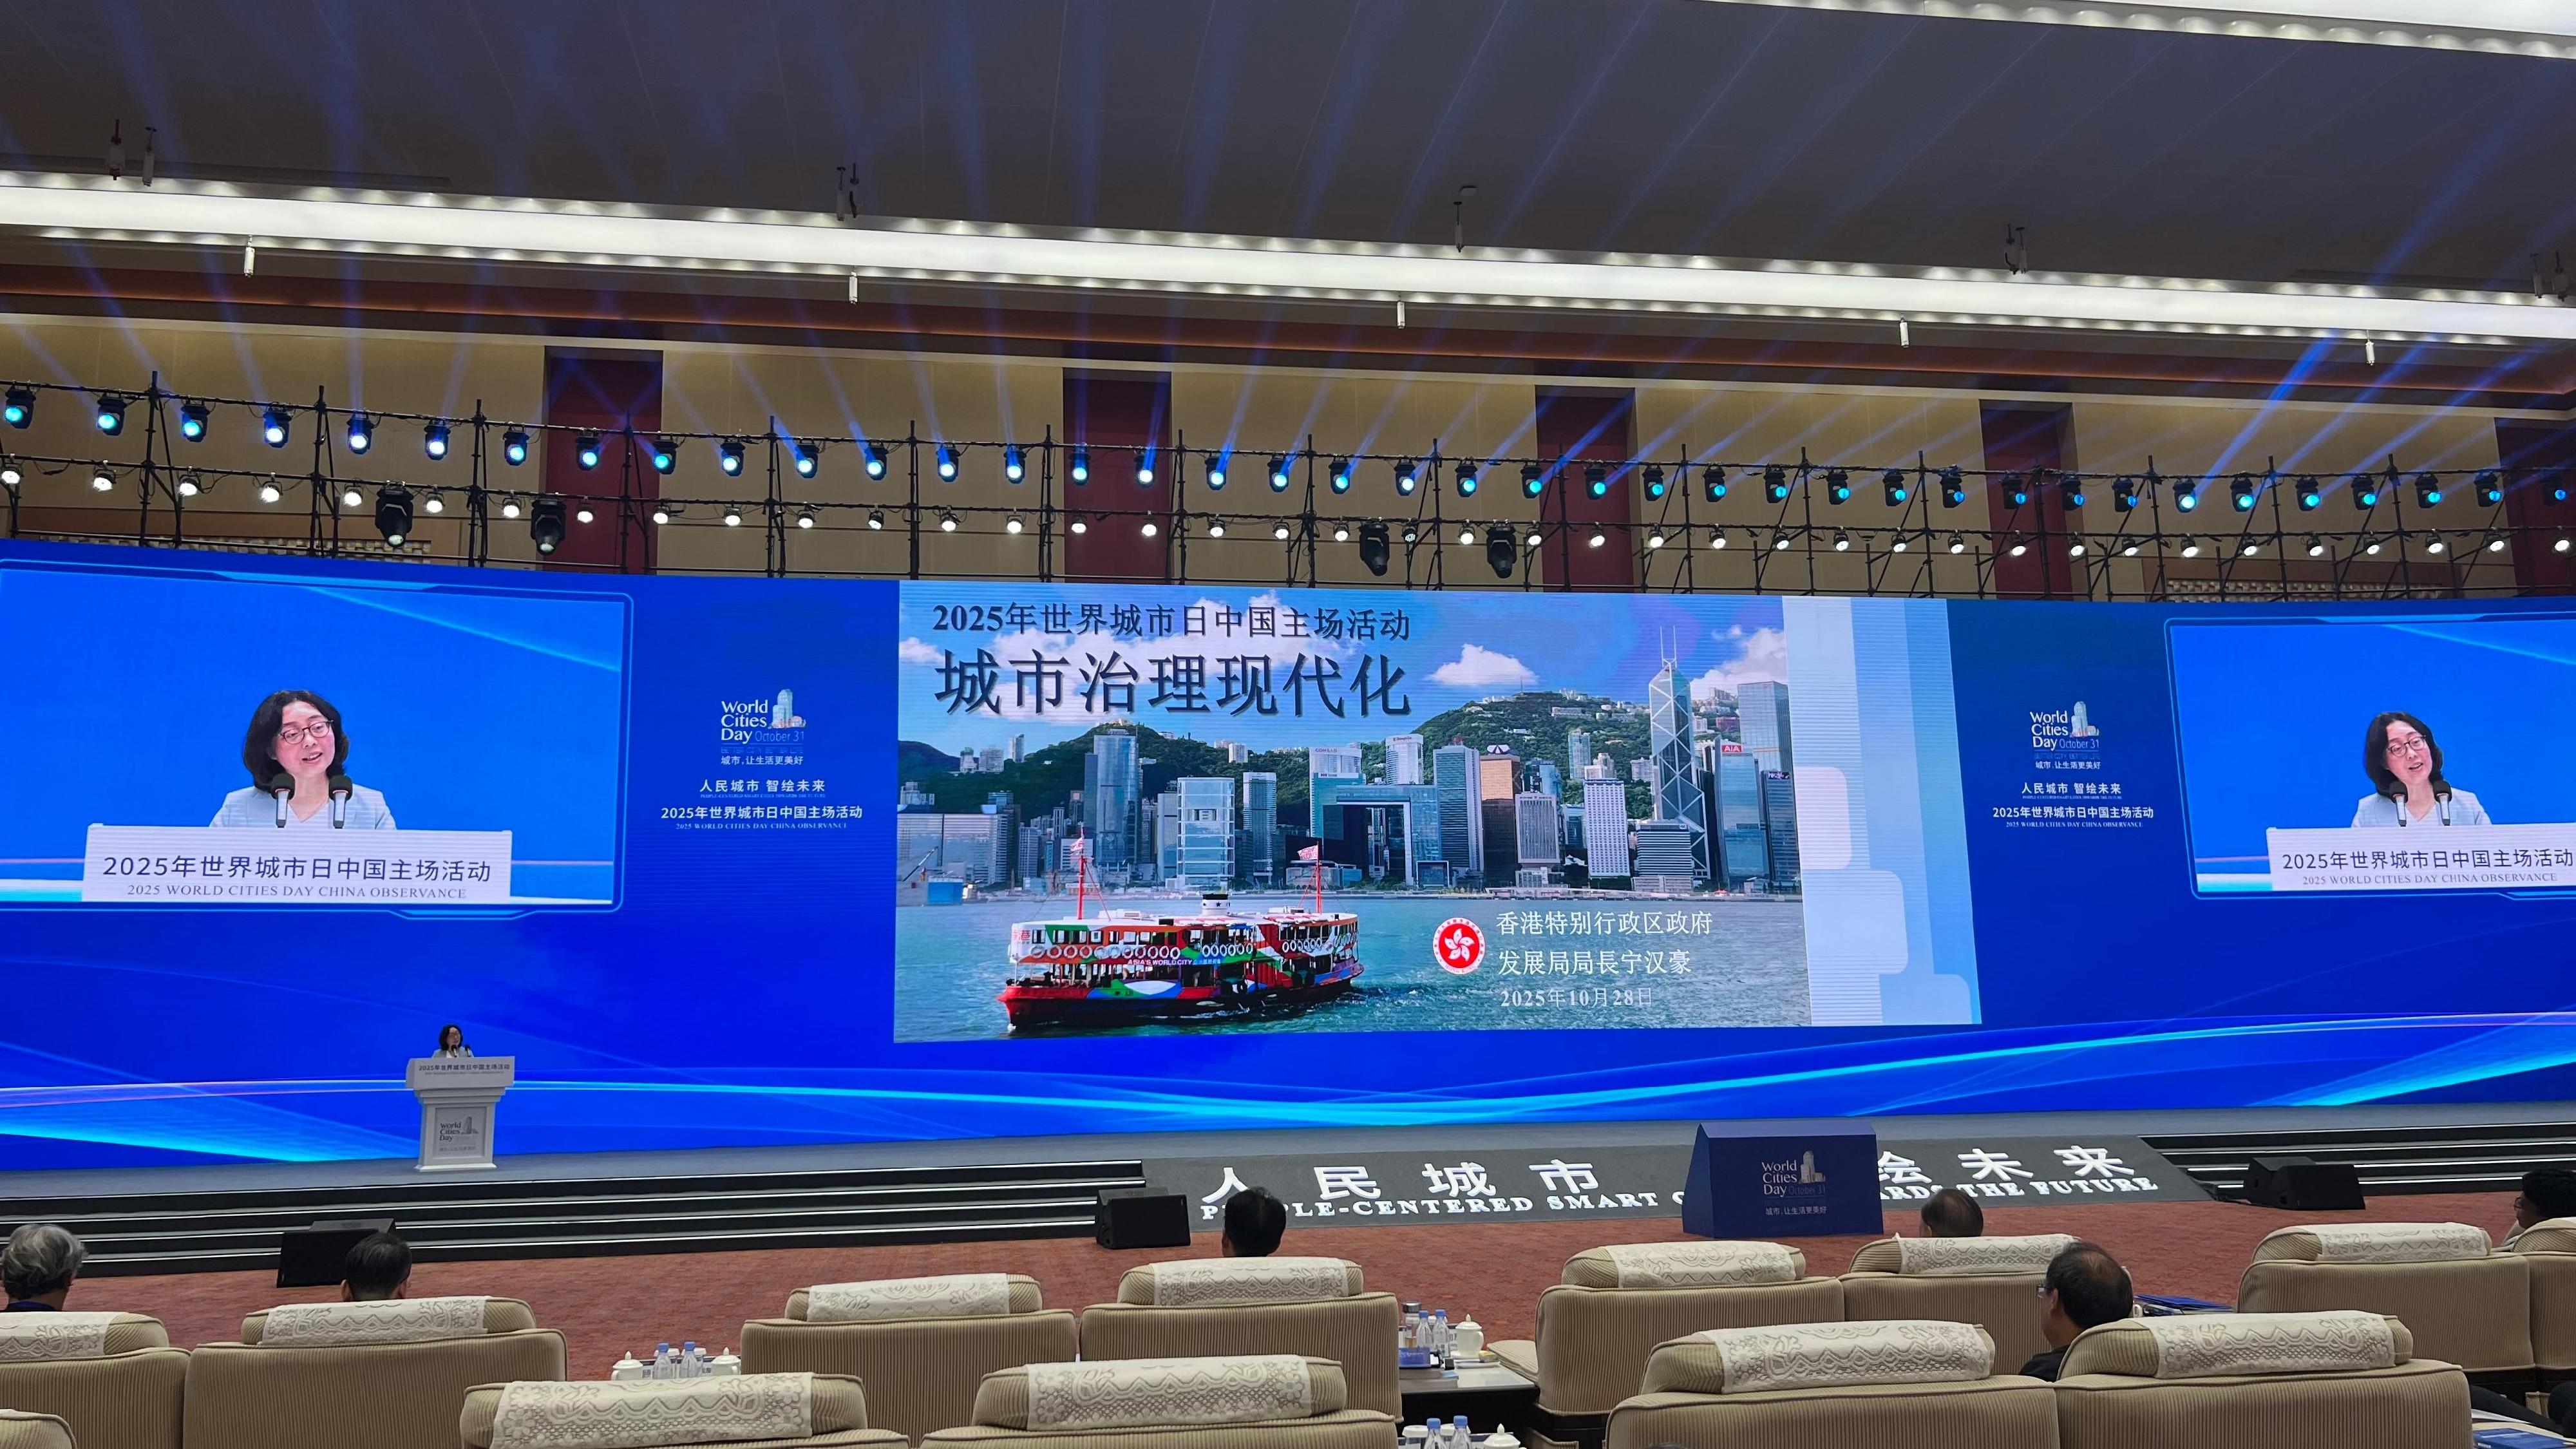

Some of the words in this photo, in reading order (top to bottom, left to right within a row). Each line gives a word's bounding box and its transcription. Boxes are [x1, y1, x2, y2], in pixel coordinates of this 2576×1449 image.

[933, 601, 1410, 641] 2025年世界城市日中国主场活动
[934, 649, 1412, 719] 城市治理现代化
[721, 699, 768, 714] World
[721, 712, 768, 728] Cities
[2029, 710, 2068, 723] World
[721, 728, 753, 744] Day
[755, 730, 791, 742] October
[793, 730, 804, 742] 31
[2031, 722, 2069, 736] Cities
[2032, 736, 2058, 752] Day
[2059, 738, 2088, 749] October
[2090, 739, 2099, 749] 31
[699, 779, 760, 793] 人民城市
[766, 779, 826, 793] 智绘未来
[2022, 782, 2069, 795] 人民城市
[2073, 782, 2121, 795] 智绘未来
[661, 806, 863, 819] 2025年世界城市日中国主场活动
[1993, 806, 2154, 819] 2025年世界城市日中国主场活动
[2282, 848, 2573, 869] 2025年世界城市日中国主场活动
[103, 855, 491, 883] 2025年世界城市日中国主场活动
[2302, 875, 2326, 886] 2025
[2330, 875, 2372, 885] WORLD
[2374, 875, 2411, 884] CITIES
[2414, 874, 2438, 884] DAY
[2441, 873, 2478, 883] CHINA
[2481, 873, 2557, 882] OBSERVANCE
[127, 885, 161, 896] 2025
[166, 886, 224, 896] WORLD
[228, 886, 278, 897] CITIES
[283, 887, 314, 898] DAY
[318, 887, 366, 898] CHINA
[370, 887, 466, 899] OBSERVANCE
[1495, 910, 1713, 936] 香港特别行政区政府
[1498, 950, 1692, 975] 发展局局長宁汉豪
[1501, 987, 1653, 1008] 2025年10月28日
[1761, 1159, 1797, 1171] World
[1202, 1159, 1600, 1204] 人民城市
[1877, 1145, 2136, 1184] 绘未来
[1763, 1171, 1797, 1184] Cities
[1200, 1196, 1533, 1220] PLE-CENTERED
[1546, 1191, 1658, 1211] SMART
[1956, 1182, 2025, 1197] THE
[2030, 1176, 2158, 1196] FUTURE
[1763, 1184, 1787, 1198] Day
